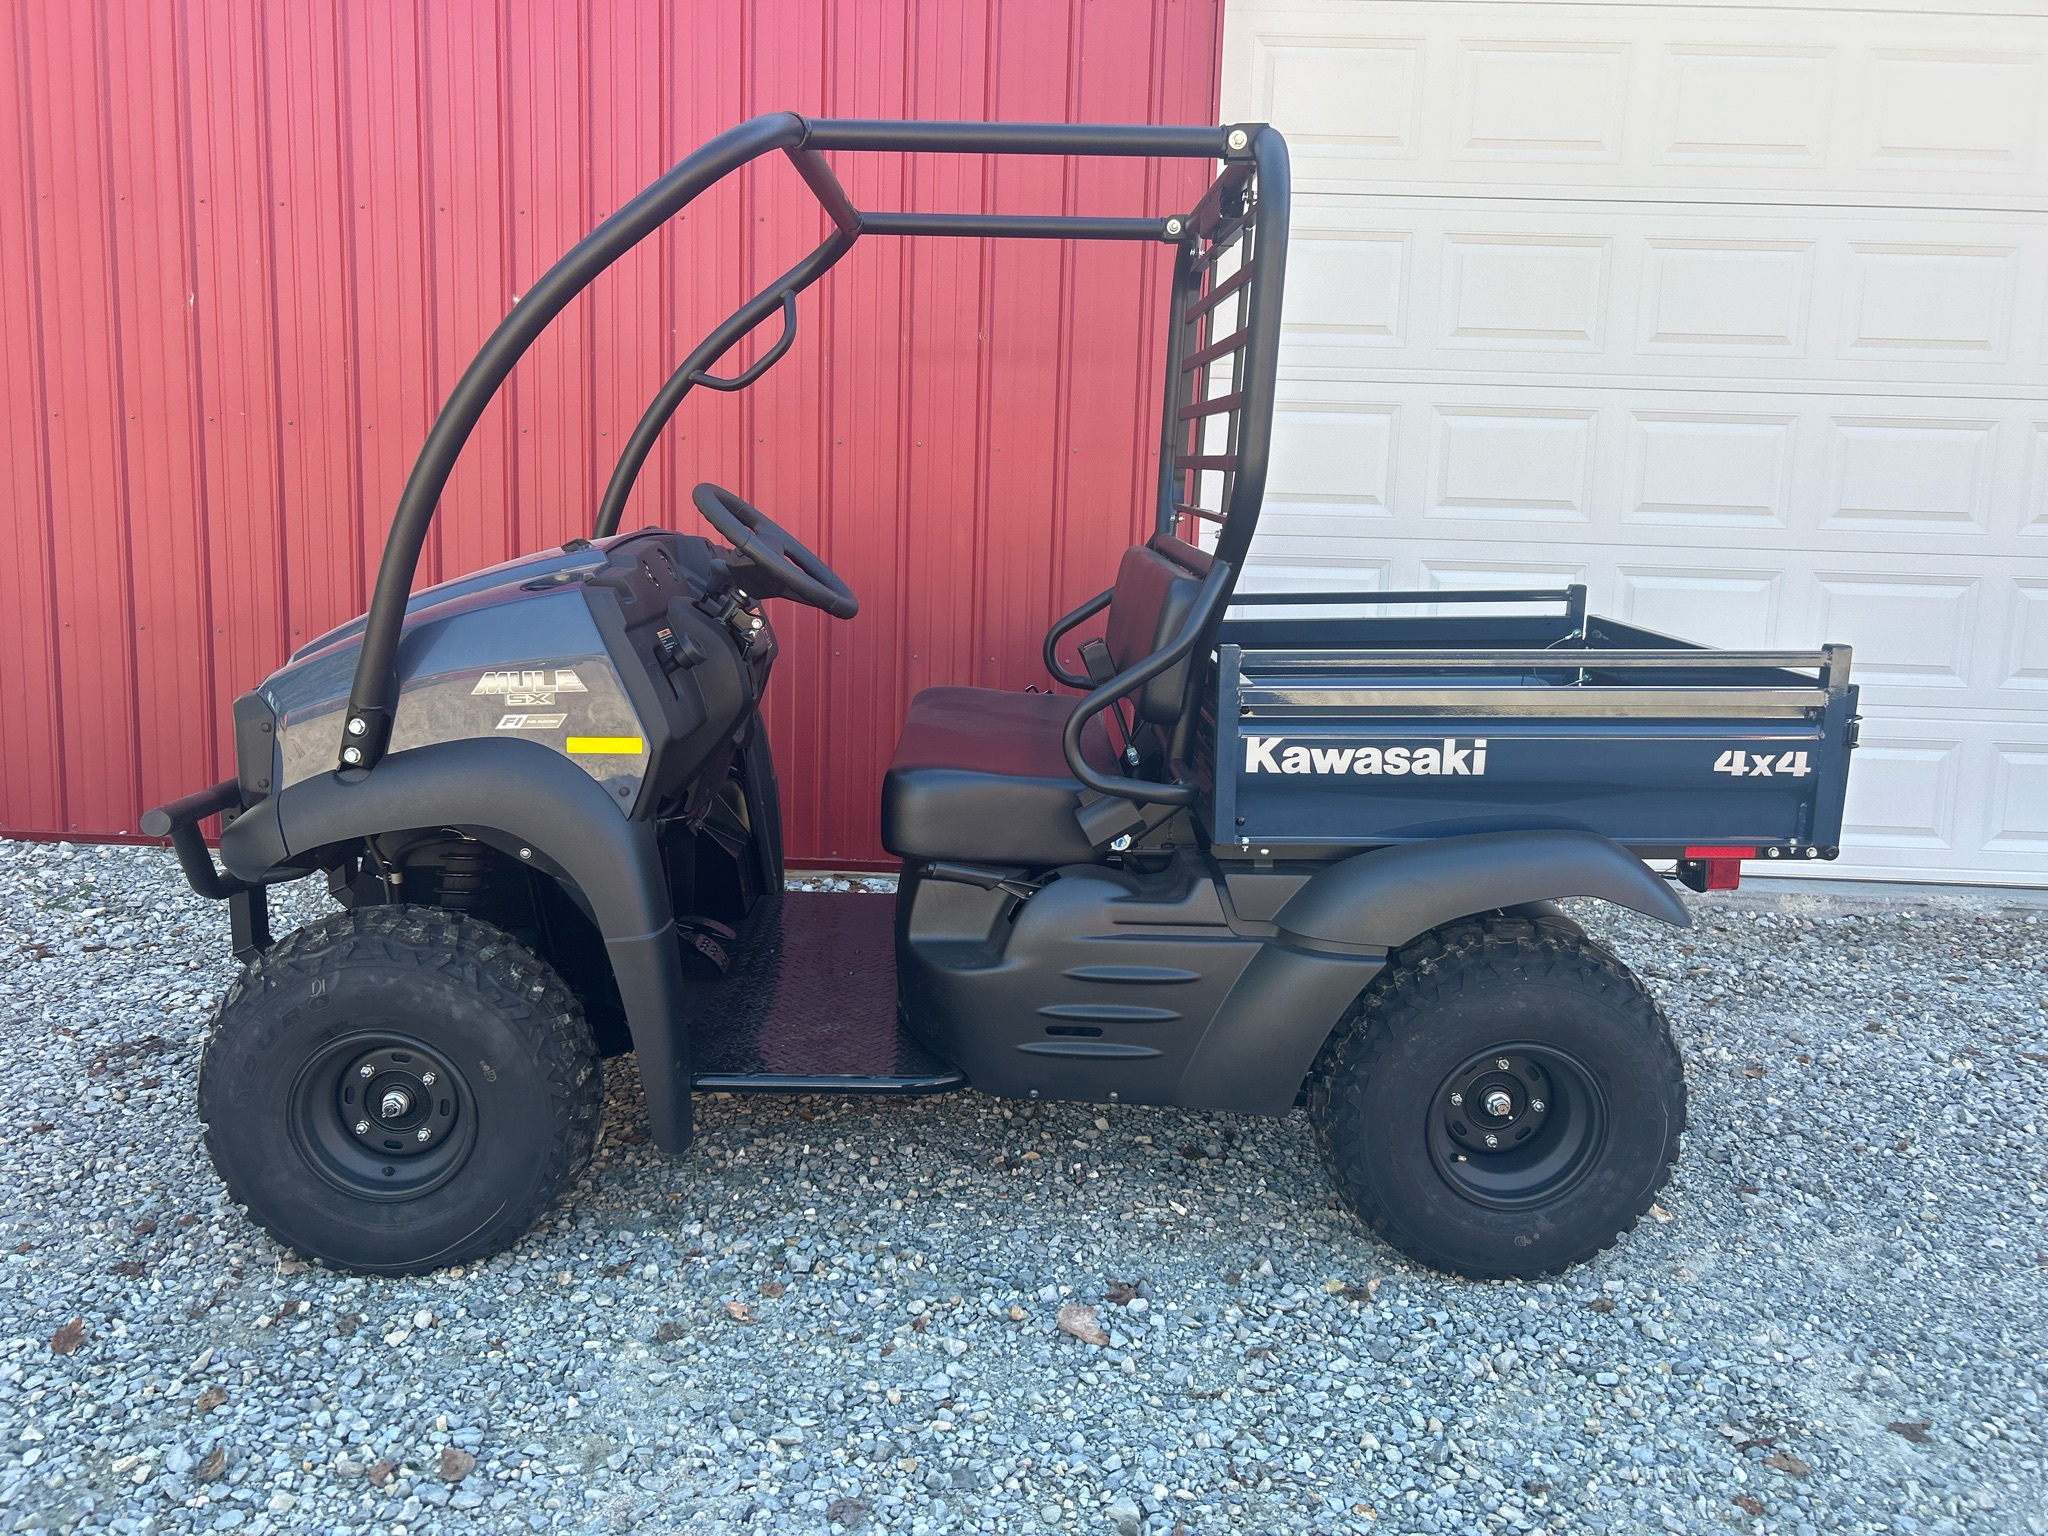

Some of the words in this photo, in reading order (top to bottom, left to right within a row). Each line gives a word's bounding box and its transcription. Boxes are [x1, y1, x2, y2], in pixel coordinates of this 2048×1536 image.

[471, 670, 588, 695] MULE
[508, 694, 552, 705] SX
[501, 717, 524, 726] FI
[1245, 737, 1487, 775] Kawasaki
[1713, 750, 1812, 777] 4x4
